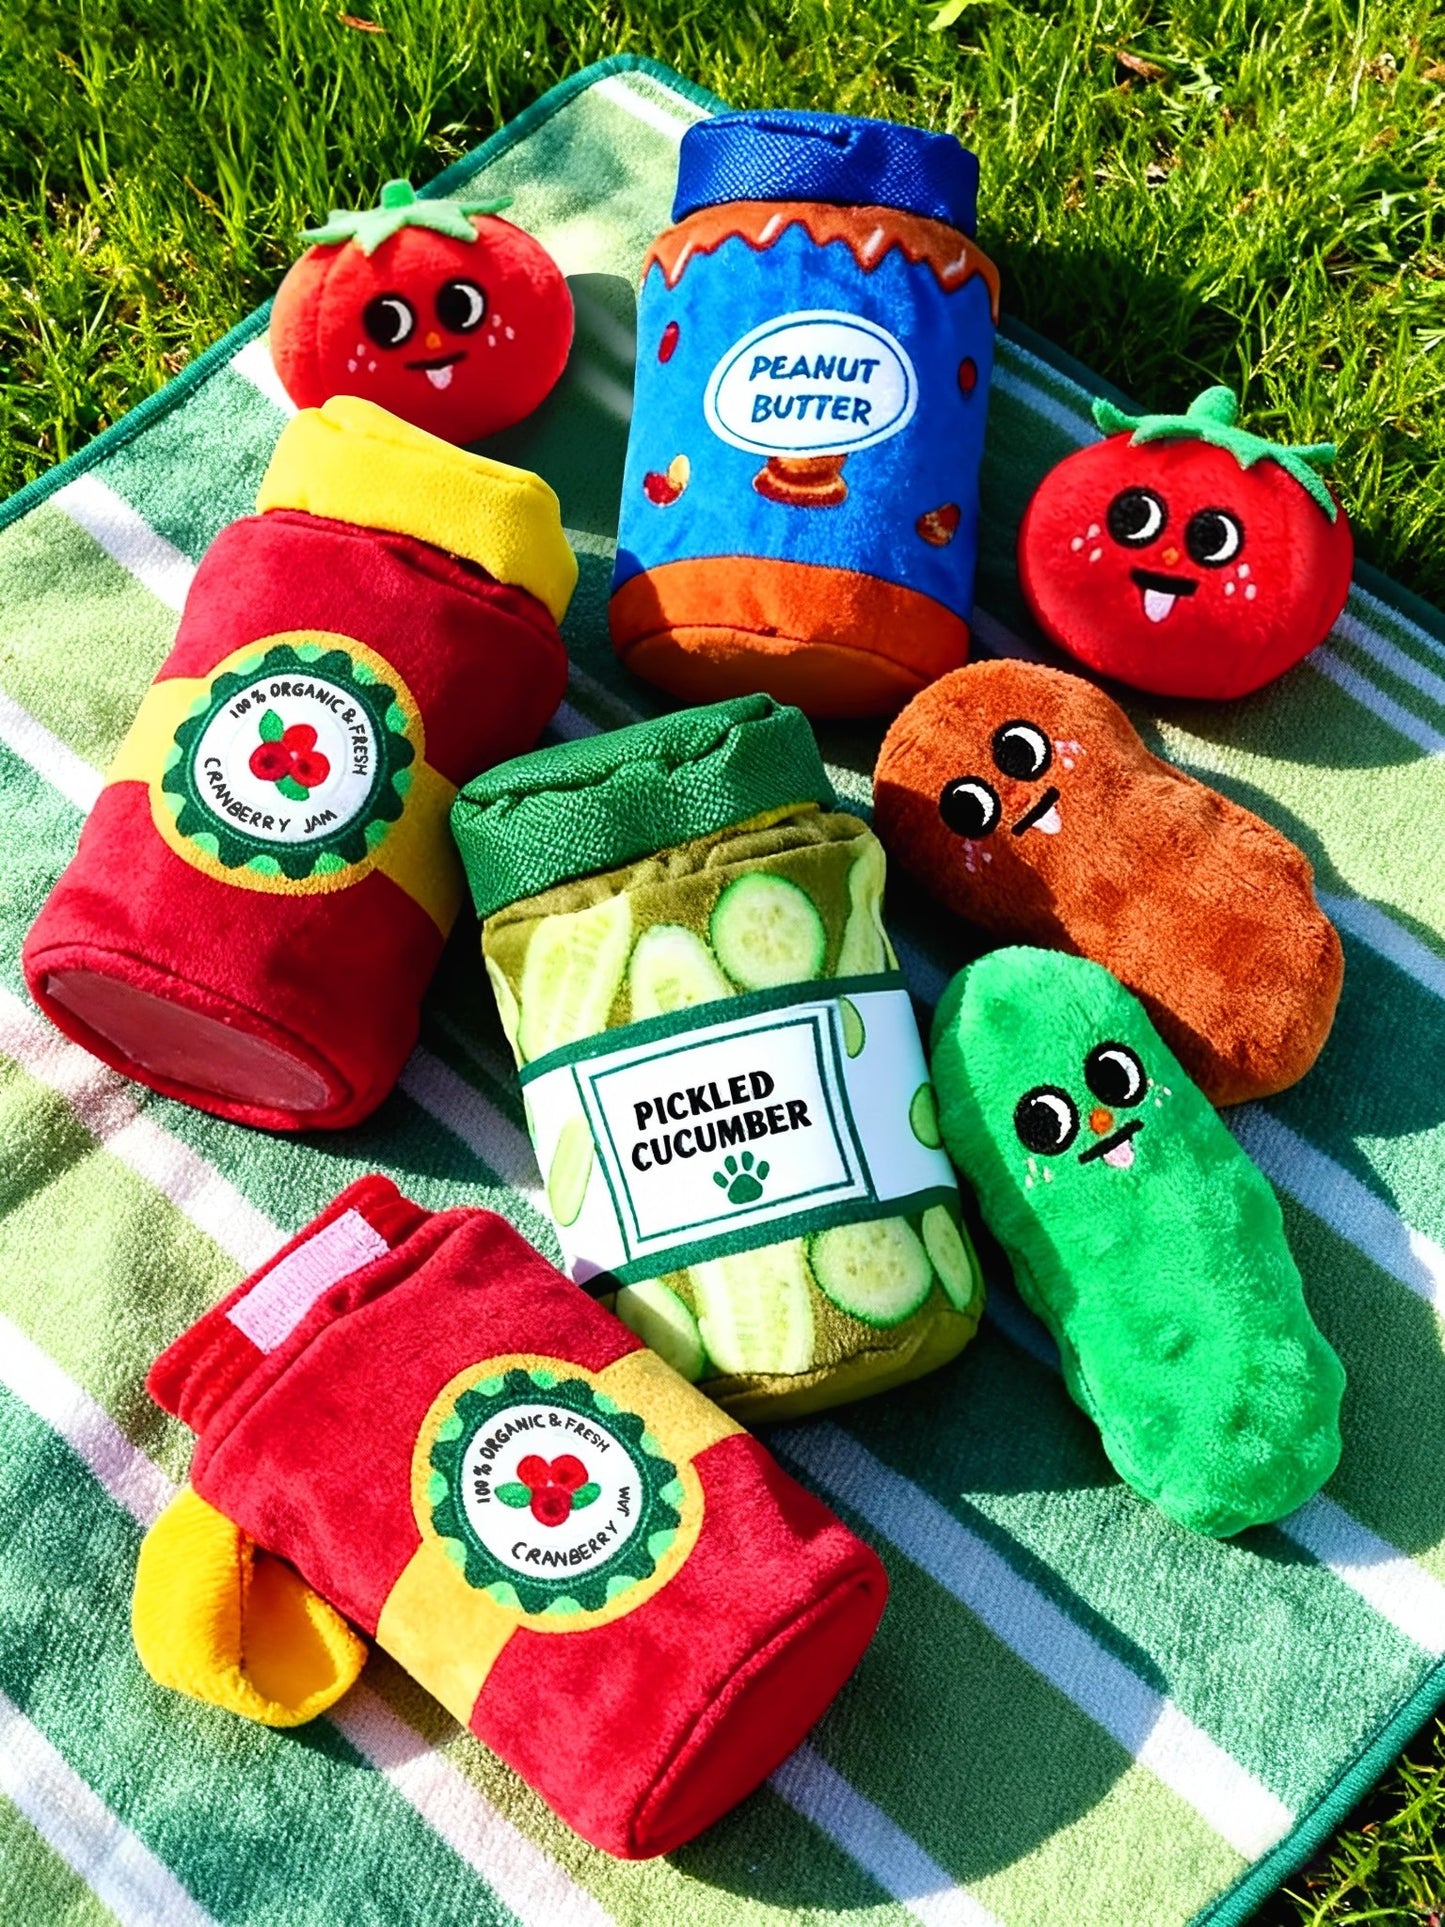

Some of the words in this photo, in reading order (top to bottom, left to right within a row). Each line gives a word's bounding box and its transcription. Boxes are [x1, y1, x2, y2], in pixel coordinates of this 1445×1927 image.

[749, 354, 880, 384] PEANUT
[751, 394, 872, 426] BUTTER
[270, 681, 345, 715] ORGANIC
[348, 724, 368, 776] FRESH
[204, 757, 291, 833] CRANBERRY
[303, 809, 338, 834] JAM
[633, 1070, 775, 1131] PICKLED
[631, 1099, 812, 1172] CUCUMBER
[479, 1414, 546, 1460] ORGANIC
[564, 1417, 610, 1453] FRESH
[511, 1520, 618, 1567] CRANBERRY
[617, 1486, 631, 1517] JAM
